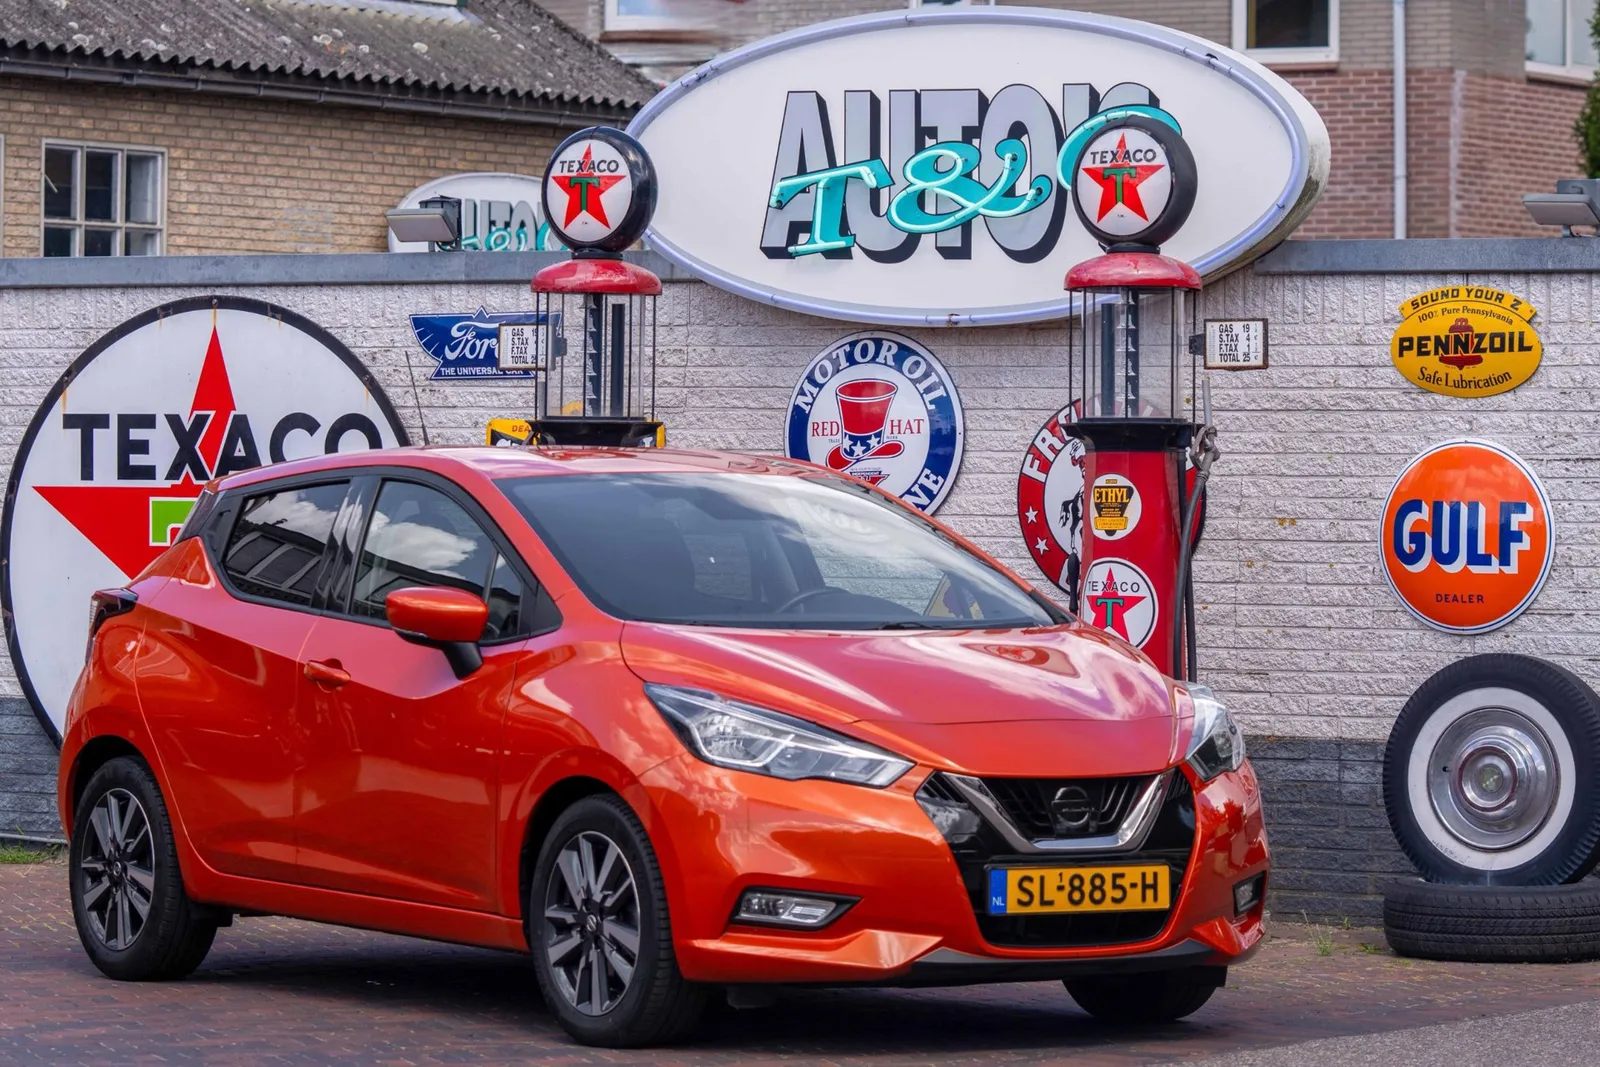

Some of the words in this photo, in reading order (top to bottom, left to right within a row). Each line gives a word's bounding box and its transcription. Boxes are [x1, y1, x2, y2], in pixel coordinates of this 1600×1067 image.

[1090, 148, 1157, 165] TEXACO
[559, 159, 619, 173] TEXACO
[759, 81, 1160, 263] AUTO'
[569, 176, 600, 211] T
[1103, 167, 1137, 204] T
[1411, 288, 1460, 310] SOUND
[1465, 287, 1505, 304] YOUR
[1510, 299, 1523, 311] Z
[1441, 306, 1461, 316] Pure
[1462, 306, 1513, 325] Pennsylvania
[511, 328, 524, 337] GAS
[1218, 323, 1234, 333] GAS
[1242, 323, 1250, 333] 19
[444, 321, 506, 361] For
[511, 337, 529, 346] S.TAX
[1218, 333, 1240, 343] S.TAX
[1246, 334, 1250, 342] 4
[1398, 331, 1533, 358] PENNZOIL
[511, 347, 528, 355] F.TAX
[1218, 343, 1239, 353] F.TAX
[511, 355, 529, 364] TOTAL
[1218, 353, 1240, 363] TOTAL
[1242, 353, 1250, 362] 25
[440, 367, 456, 376] THE
[794, 339, 899, 415] MOTOR
[902, 355, 947, 410] OIL
[1418, 366, 1442, 386] Safe
[1445, 371, 1512, 389] Lubrication
[811, 421, 840, 437] RED
[889, 418, 925, 435] HAT
[62, 412, 383, 481] TEXACO
[1094, 487, 1130, 503] ETHYL
[1393, 499, 1534, 575] GULF
[1088, 581, 1140, 593] TEXACO
[1435, 593, 1485, 604] DEALER
[1096, 597, 1125, 627] T
[1016, 871, 1159, 907] SL-885-H
[992, 897, 1005, 906] NL
